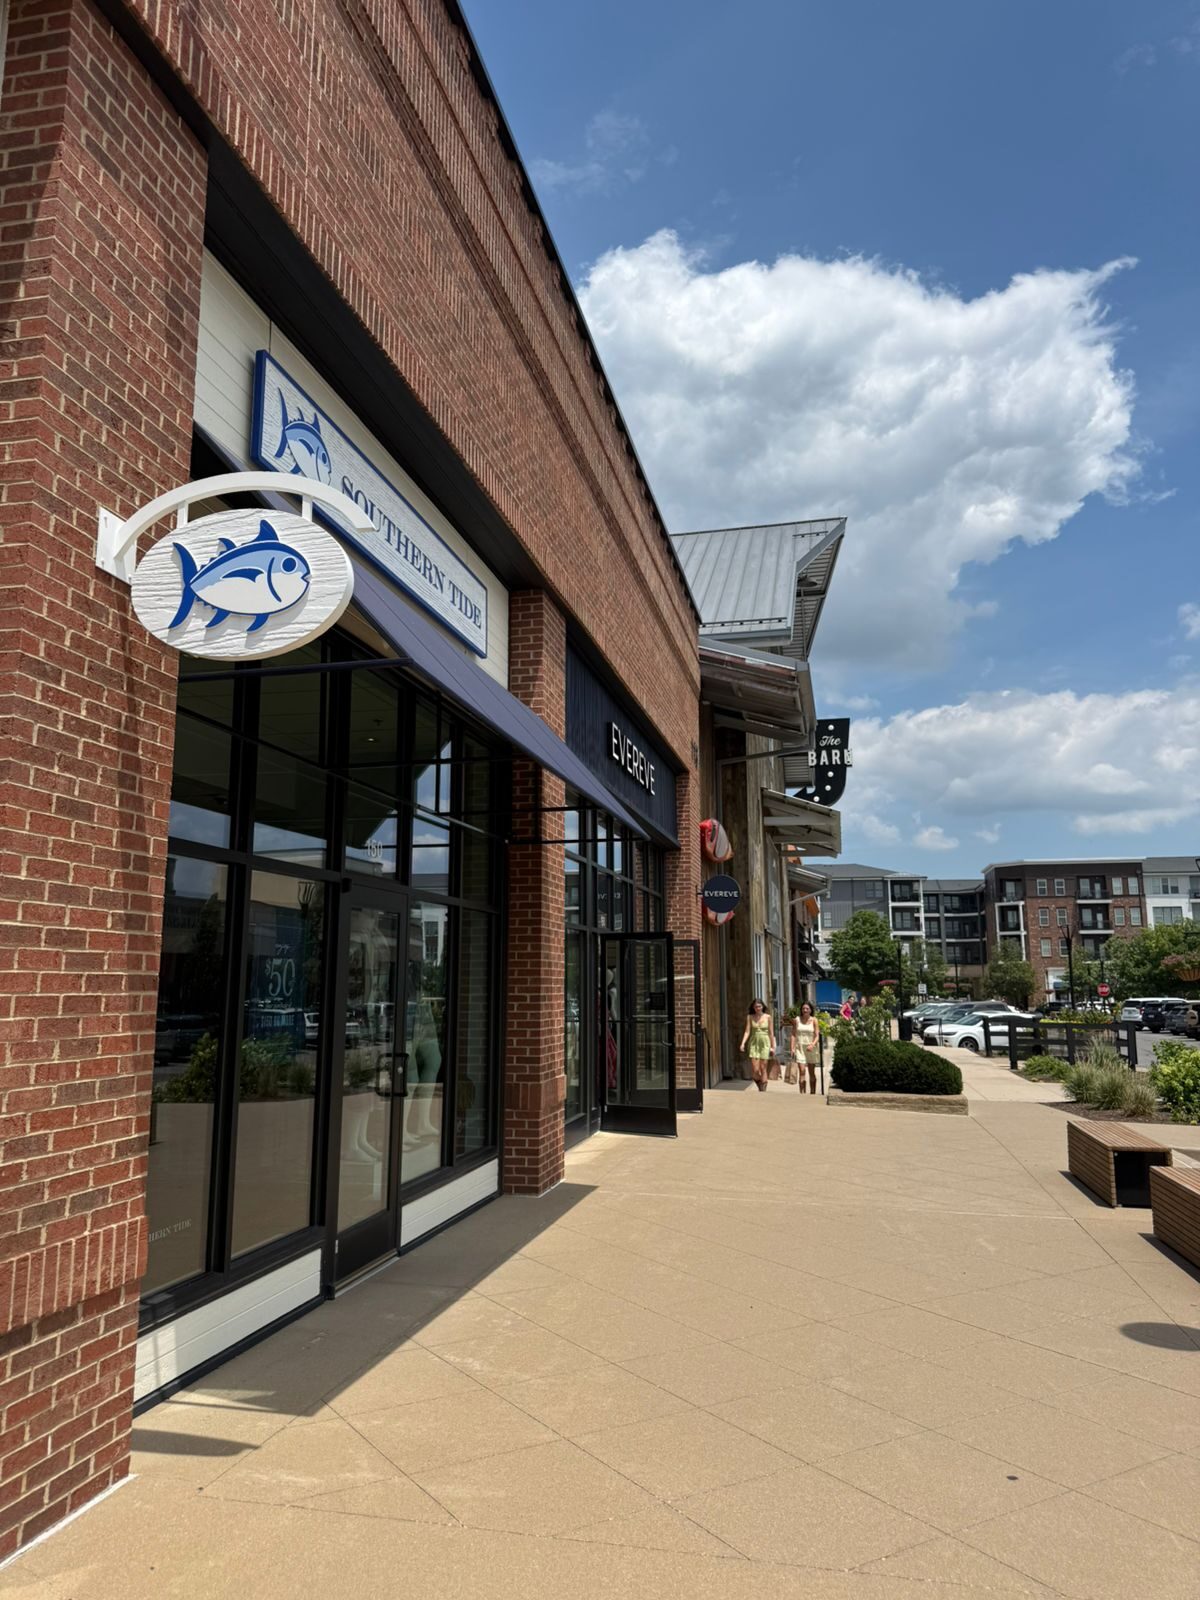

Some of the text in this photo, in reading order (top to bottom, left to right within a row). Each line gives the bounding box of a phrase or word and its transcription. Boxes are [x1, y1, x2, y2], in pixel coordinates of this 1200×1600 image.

[342, 475, 482, 629] SOUTHERN TIDE
[819, 735, 841, 747] The
[611, 721, 656, 796] EVEREVE
[808, 748, 852, 767] BARN
[367, 839, 383, 858] 150
[704, 890, 739, 898] EVEREVE
